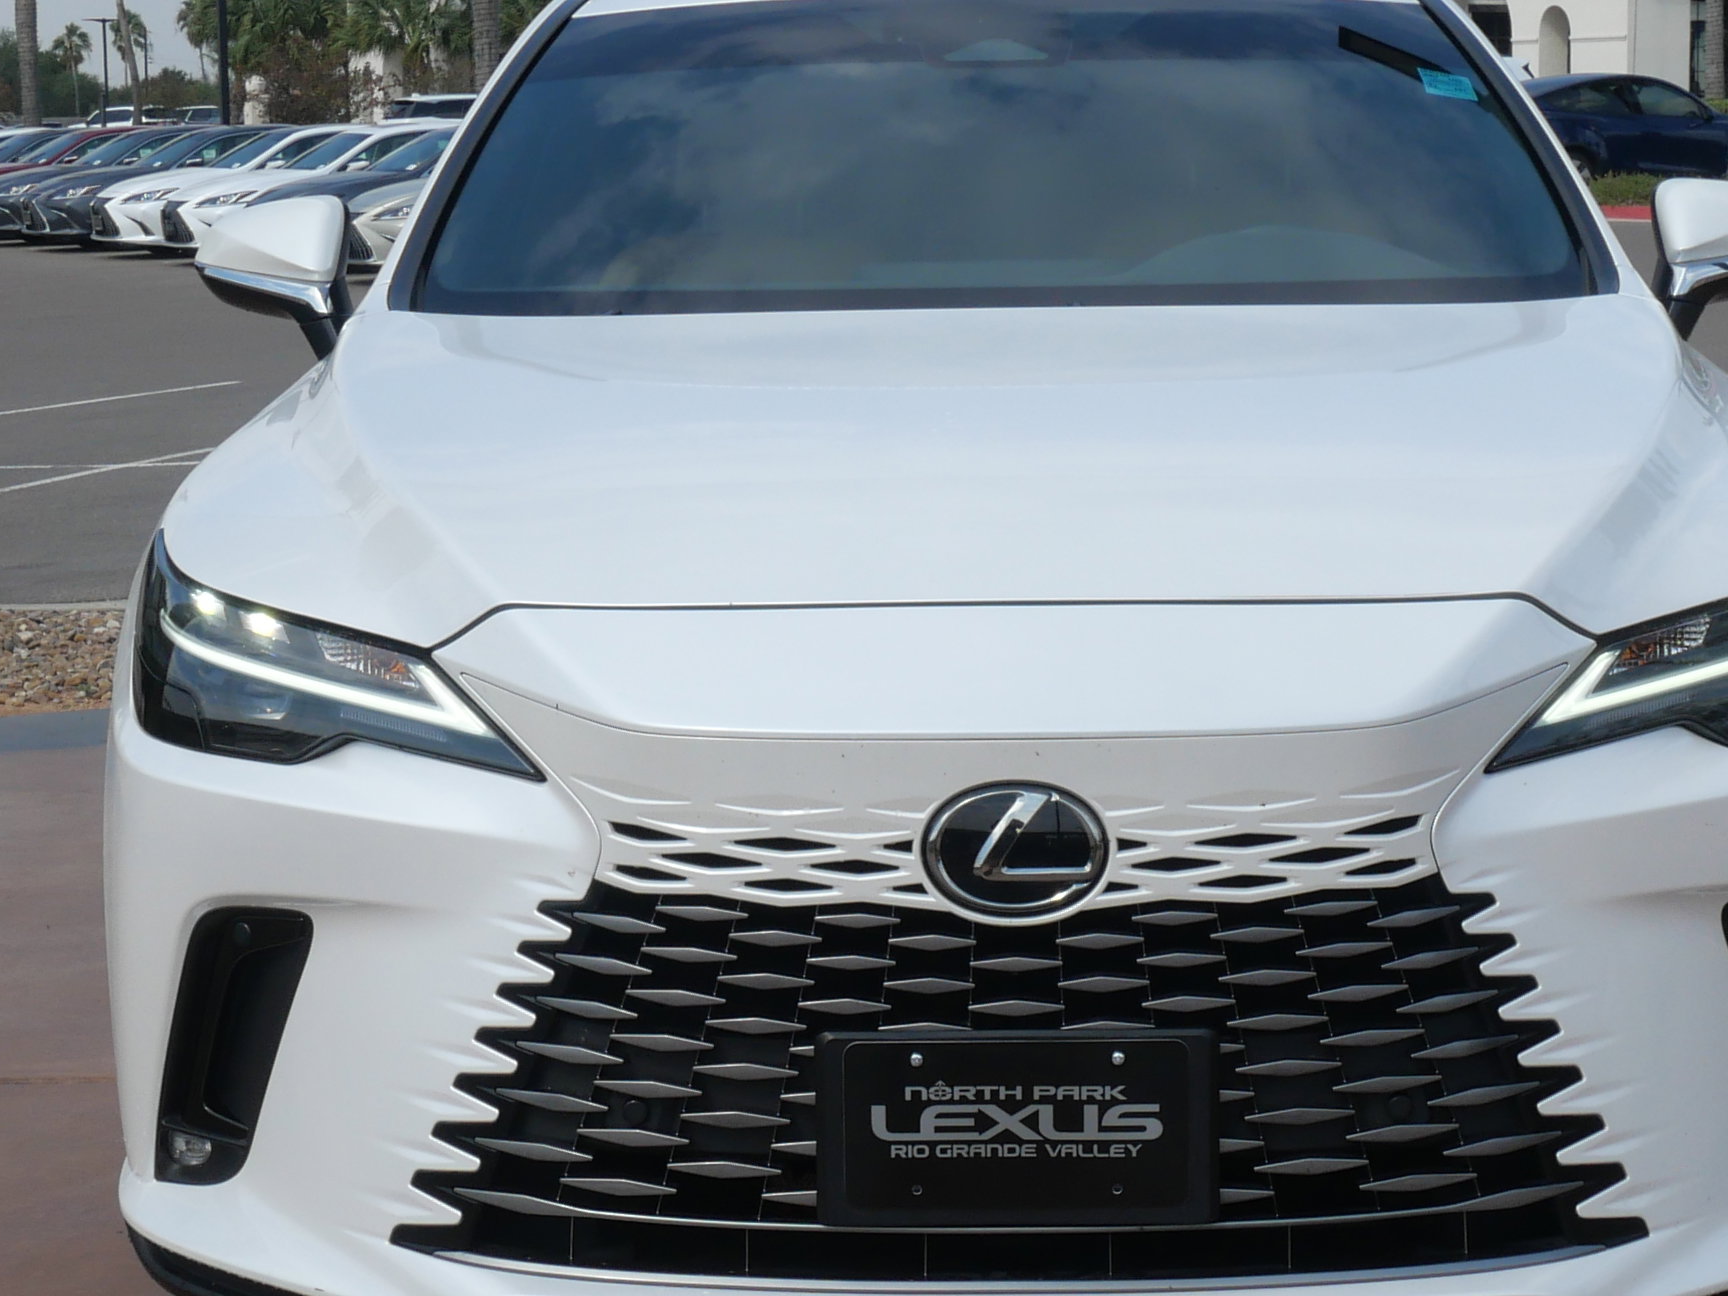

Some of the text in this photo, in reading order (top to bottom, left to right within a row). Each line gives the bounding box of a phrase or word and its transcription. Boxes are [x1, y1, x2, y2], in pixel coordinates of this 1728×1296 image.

[904, 1080, 1127, 1101] NORTH PARK
[871, 1104, 1164, 1141] LEXUS
[890, 1143, 1143, 1158] RIO GRANDE VALLEY
